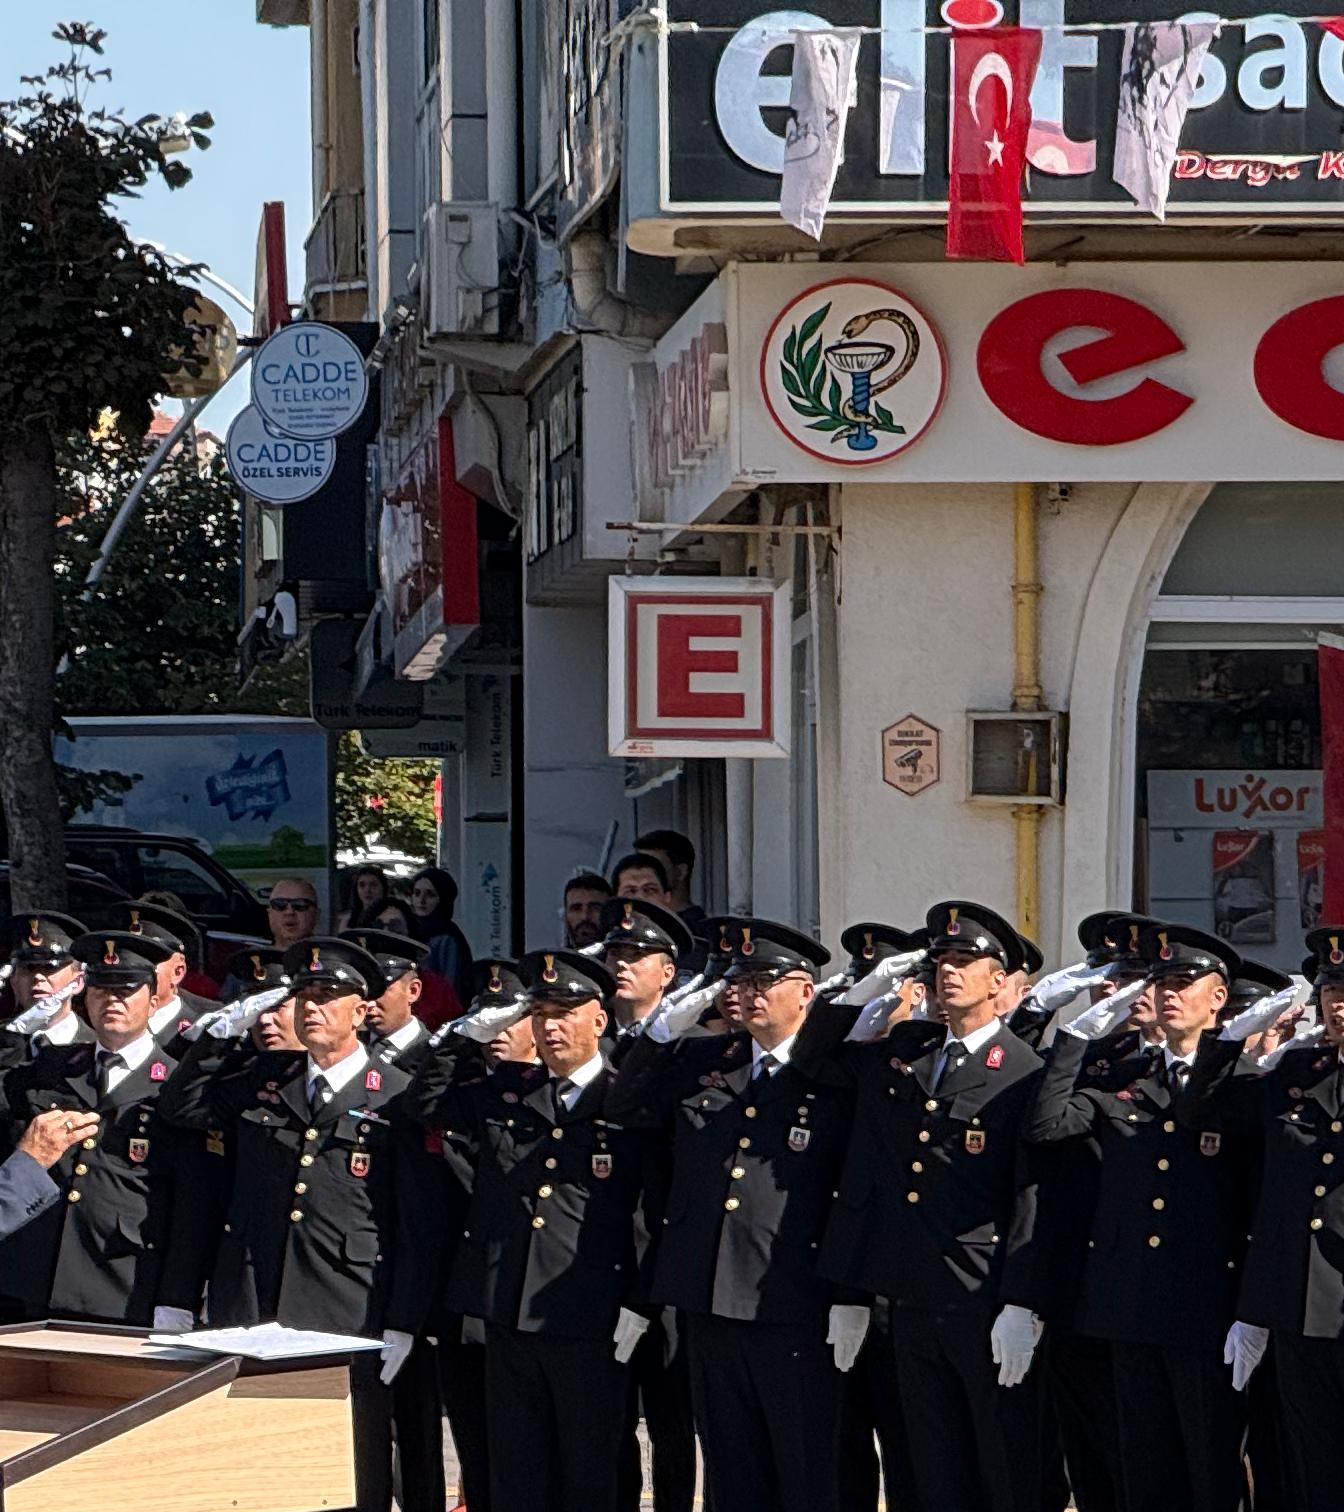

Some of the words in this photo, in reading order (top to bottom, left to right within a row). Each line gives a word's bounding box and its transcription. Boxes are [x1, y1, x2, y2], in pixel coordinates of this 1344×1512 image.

[261, 361, 358, 385] CADDE
[271, 387, 351, 402] TELEKOM
[237, 442, 326, 464] CADDE
[242, 466, 275, 479] ÖZEL
[276, 465, 323, 478] SERVİS
[657, 614, 745, 719] E
